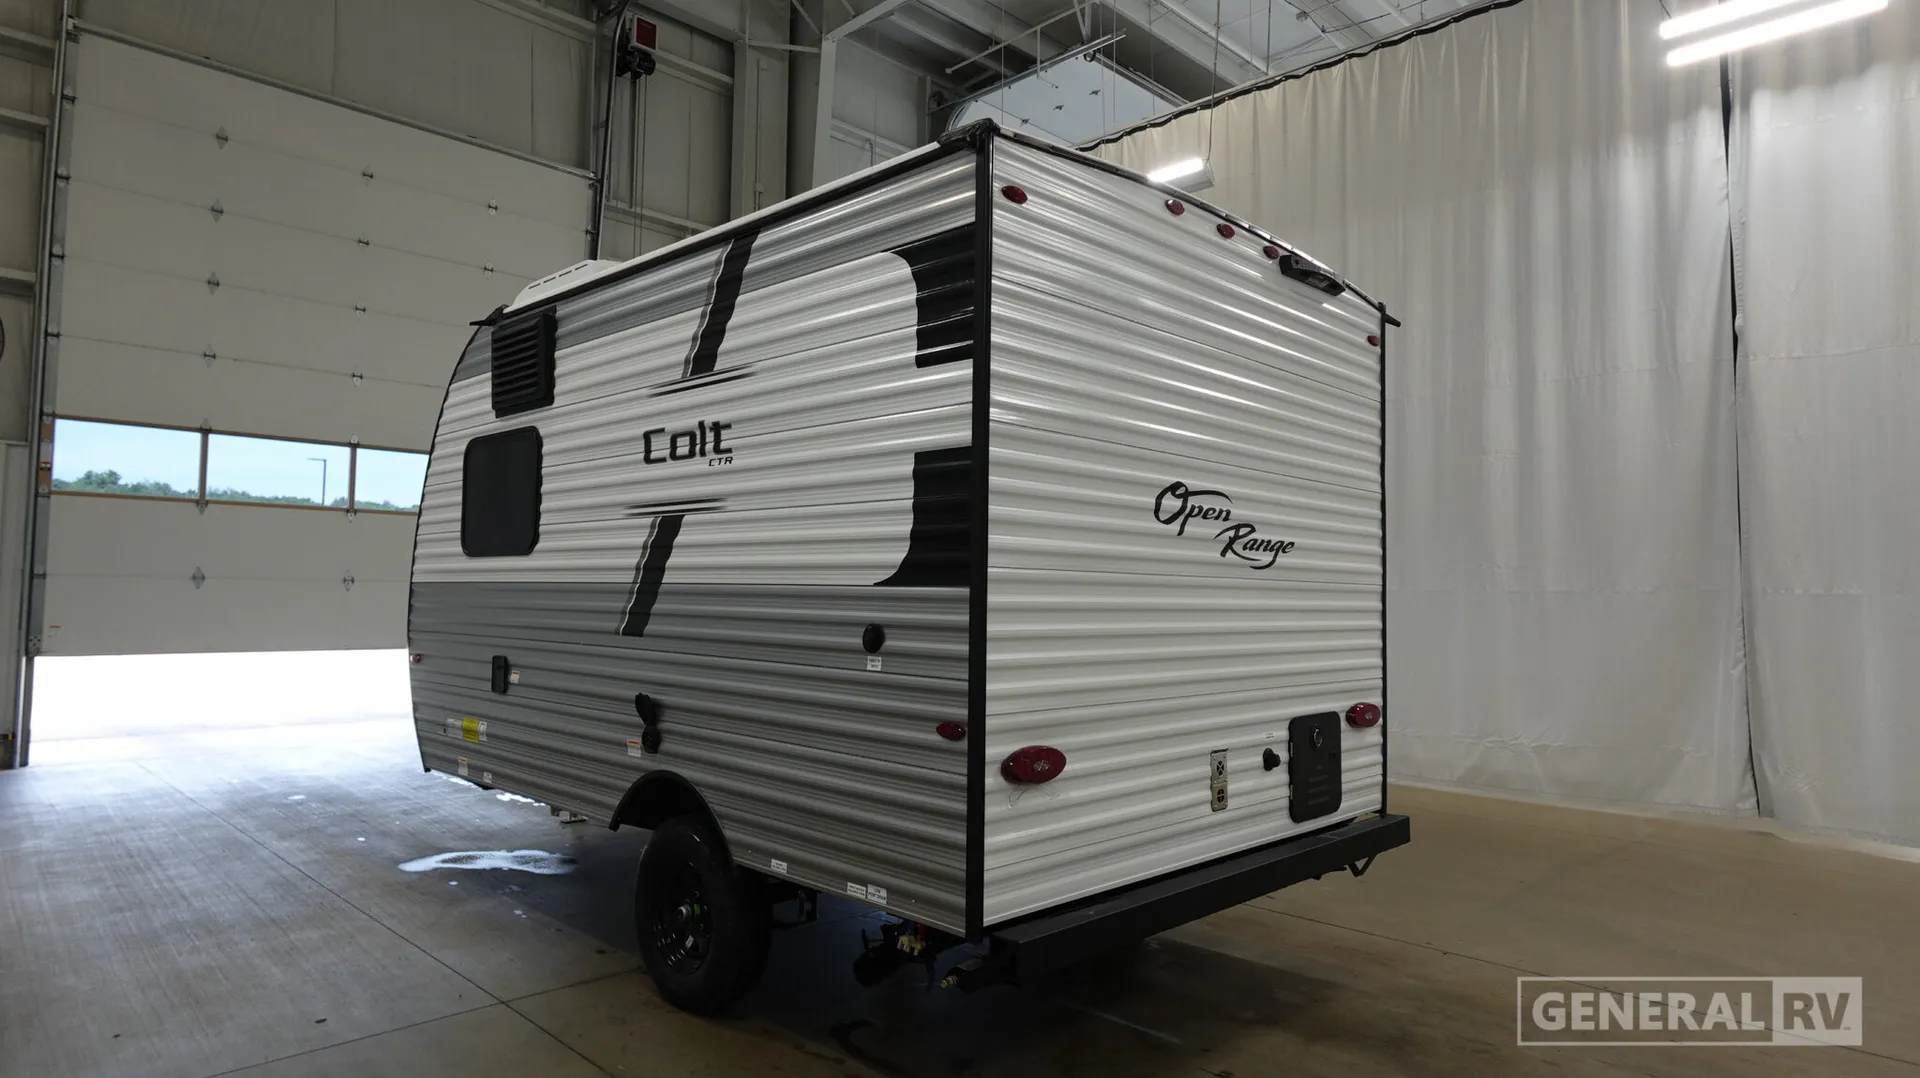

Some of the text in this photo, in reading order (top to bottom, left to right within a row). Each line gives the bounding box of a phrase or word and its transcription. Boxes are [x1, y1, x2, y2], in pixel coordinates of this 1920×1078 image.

[643, 420, 733, 465] Colt
[708, 456, 734, 467] CTR
[1153, 480, 1234, 537] Open
[1212, 523, 1295, 570] Range
